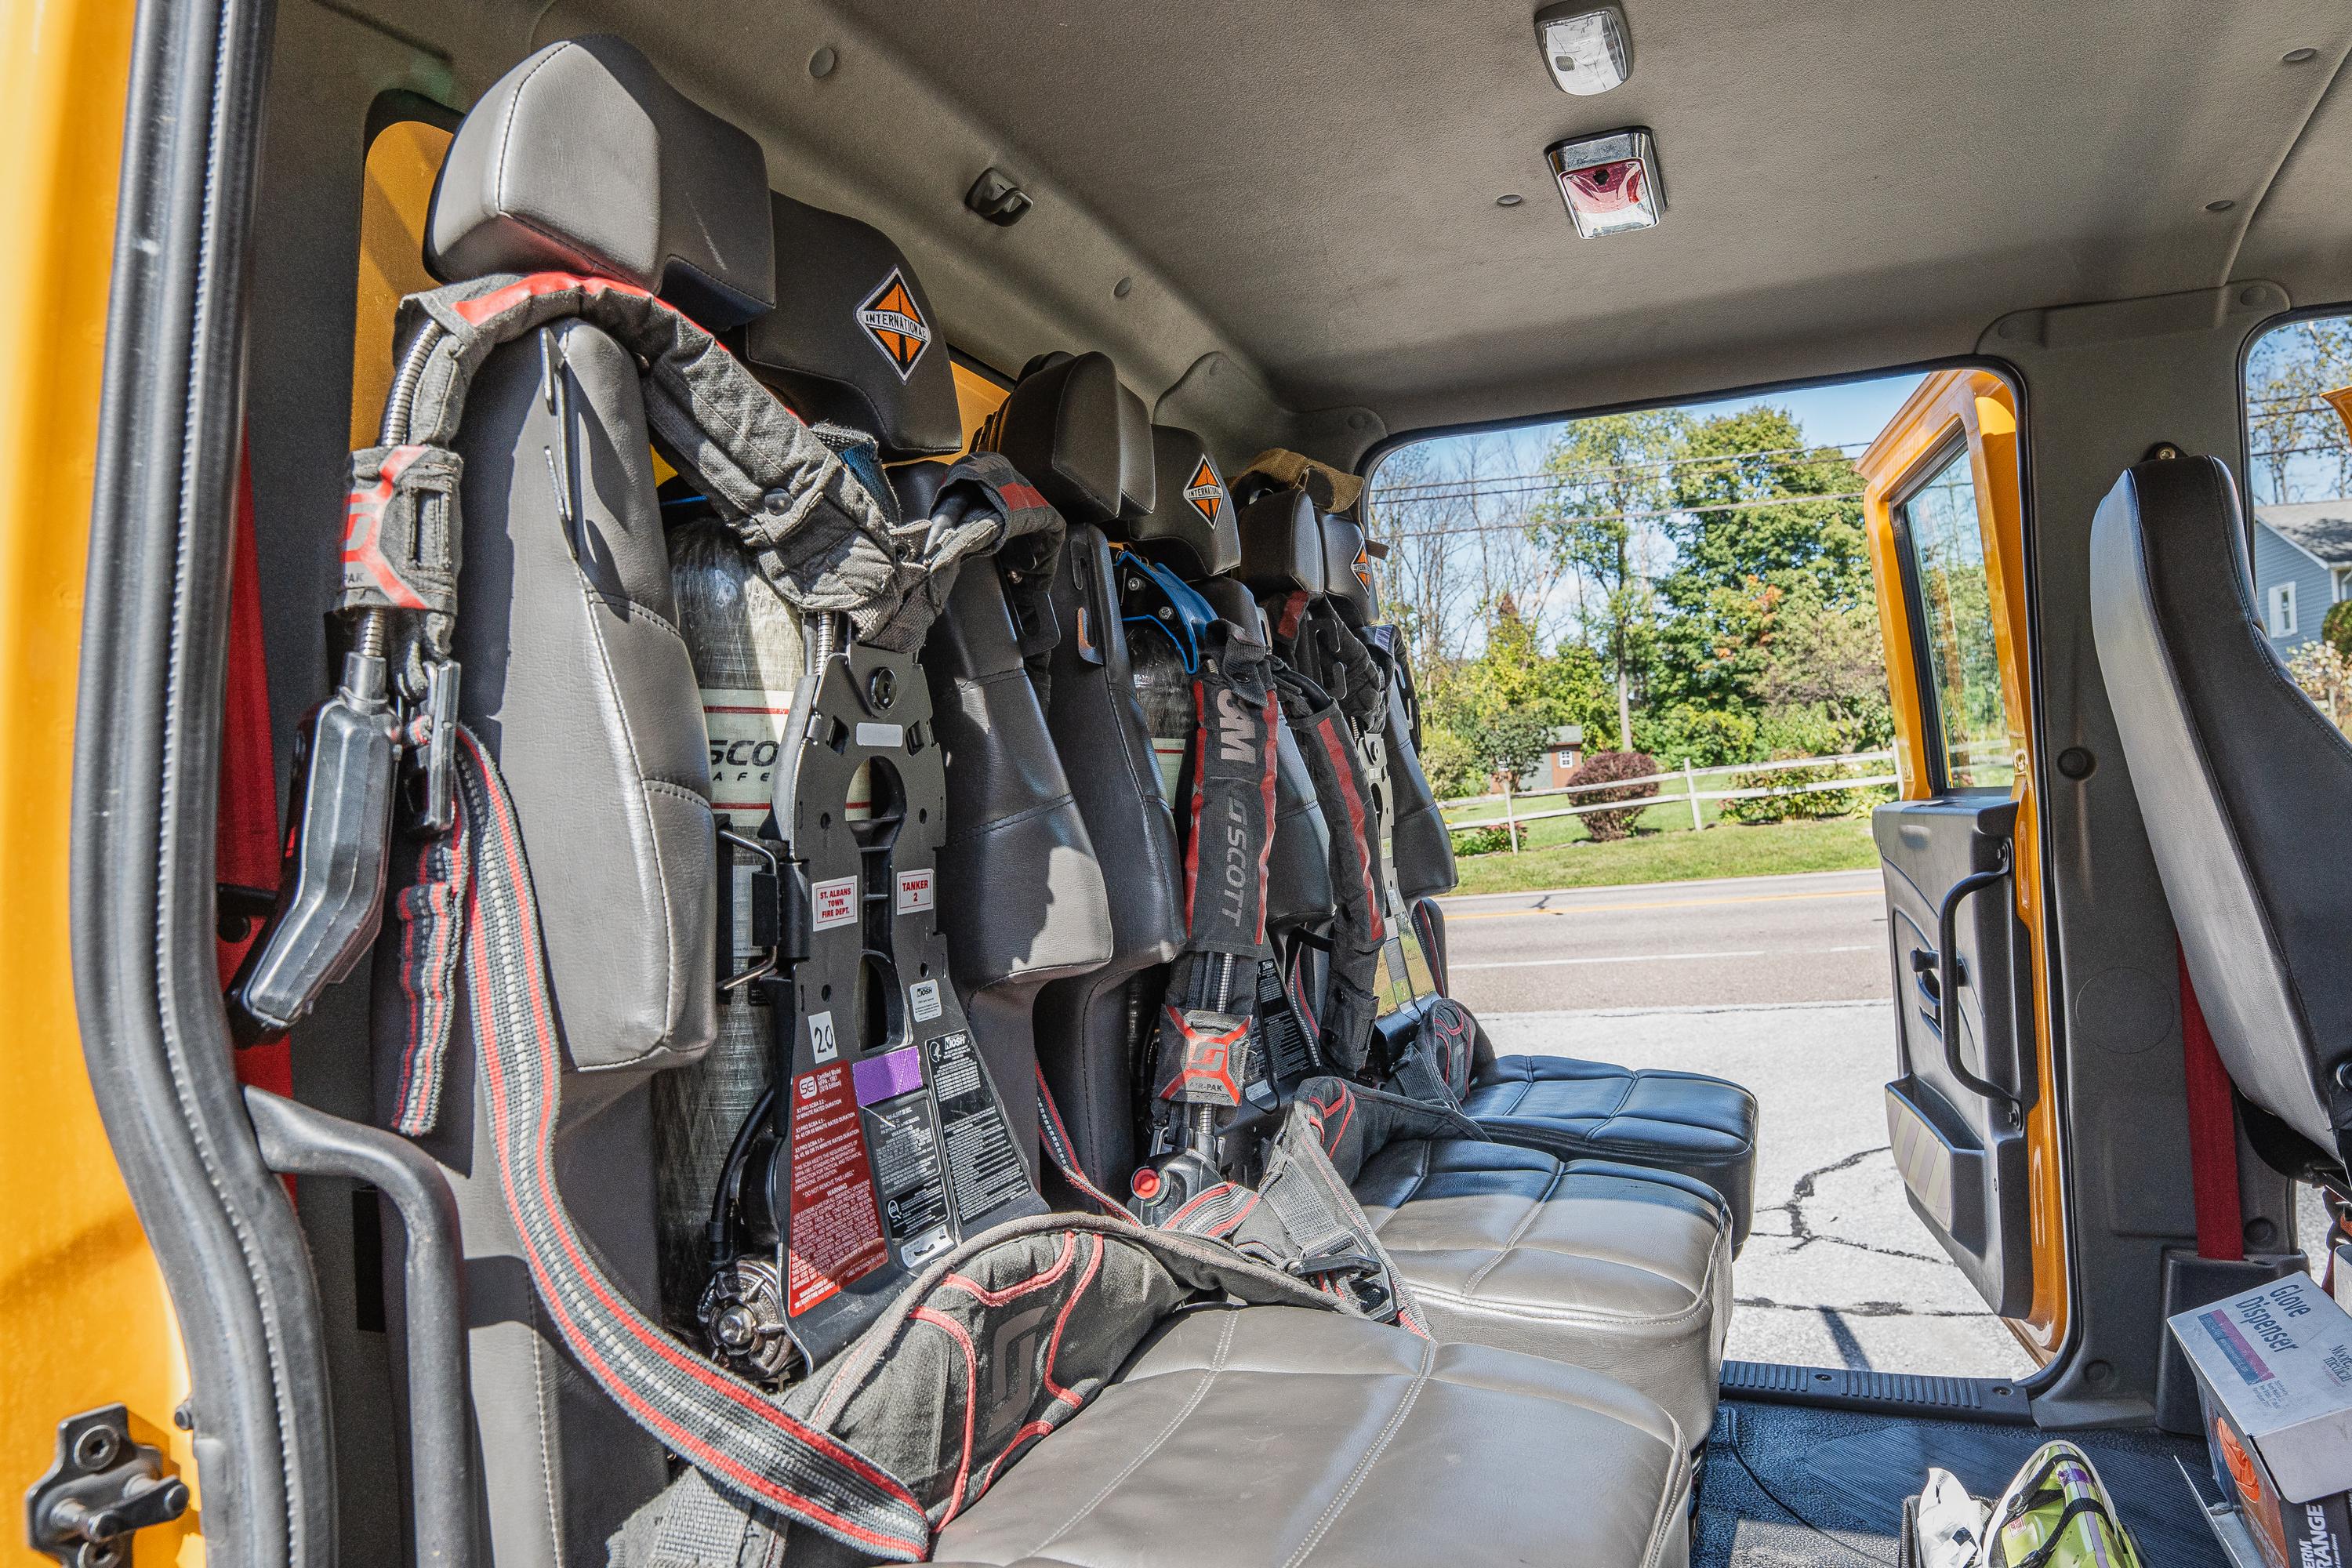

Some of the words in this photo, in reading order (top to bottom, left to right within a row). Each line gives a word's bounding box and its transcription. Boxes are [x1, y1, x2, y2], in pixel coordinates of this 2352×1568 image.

[866, 314, 926, 338] INTERNATIONAL
[1217, 688, 1256, 764] 3M
[902, 880, 929, 891] TANKER
[820, 891, 828, 900] ST.
[829, 887, 851, 898] ALBANS
[913, 893, 918, 902] 2
[828, 898, 844, 907] TOWN
[822, 909, 834, 918] FIRE
[835, 907, 849, 916] DEPT.
[917, 987, 933, 998] NIOSH
[814, 1025, 833, 1054] 20
[945, 1035, 966, 1050] NIOSH
[816, 1070, 830, 1079] Certified
[801, 1080, 815, 1095] SEI
[1189, 1080, 1223, 1092] AIR-PAK
[891, 1125, 913, 1136] WARNING
[819, 1179, 834, 1190] REMOVE
[826, 1182, 848, 1196] WARNING
[2270, 1285, 2311, 1318] Glove
[2236, 1295, 2299, 1352] Dispenser
[2323, 1357, 2352, 1382] medical
